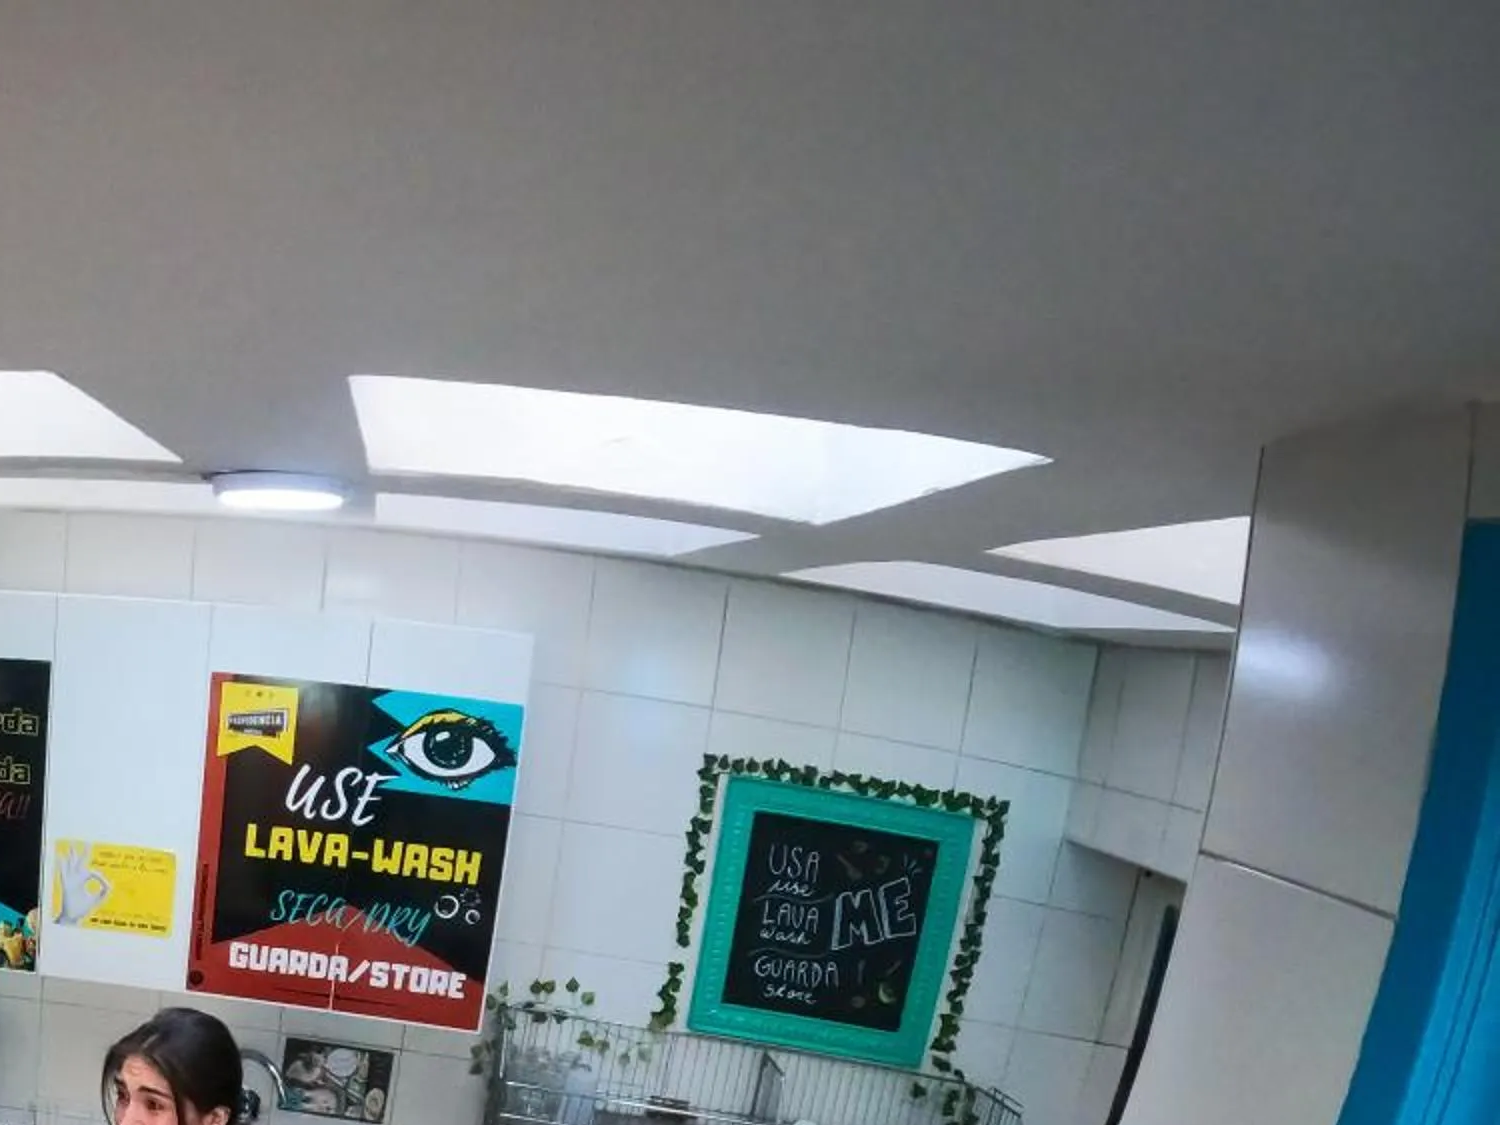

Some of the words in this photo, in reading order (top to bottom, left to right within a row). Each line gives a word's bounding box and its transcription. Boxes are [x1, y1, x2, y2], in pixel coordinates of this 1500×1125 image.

[285, 764, 399, 826] USE
[245, 823, 483, 885] LAVA-WASH
[768, 844, 820, 883] USA
[762, 900, 820, 934] LAVA
[831, 877, 917, 951] ME
[229, 941, 468, 999] GUARDA/STORE
[754, 955, 840, 988] GUARDA
